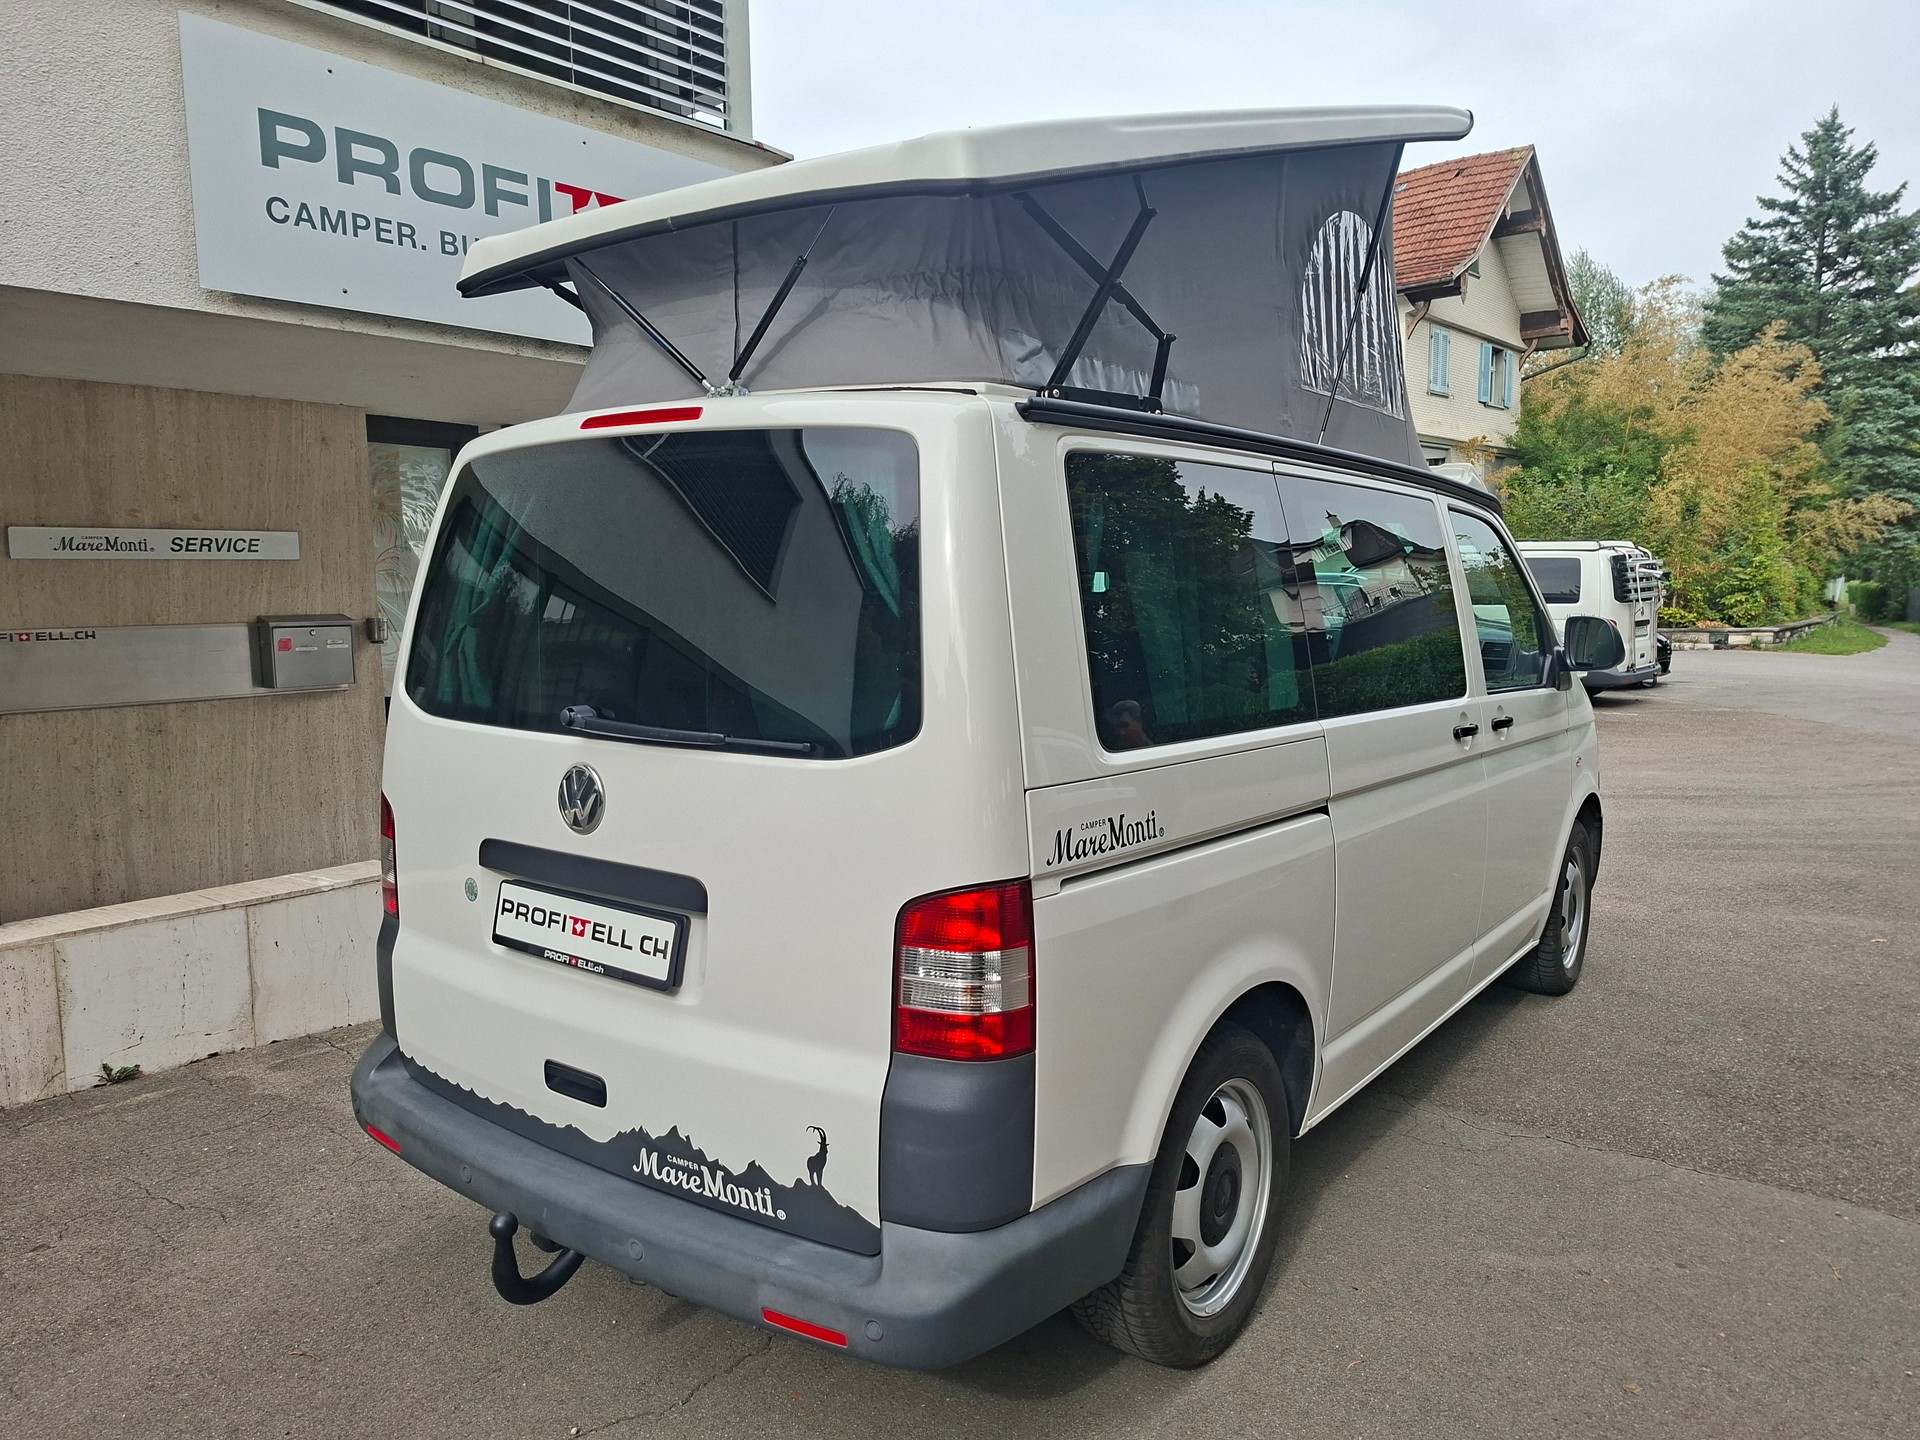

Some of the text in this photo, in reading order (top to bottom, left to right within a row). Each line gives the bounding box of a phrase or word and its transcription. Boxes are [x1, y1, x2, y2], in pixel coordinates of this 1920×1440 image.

[265, 196, 427, 252] CAMPER.
[170, 537, 260, 553] SERVICE
[1080, 818, 1107, 831] CAMPER
[639, 934, 669, 960] CH
[667, 1154, 699, 1171] CAMPER
